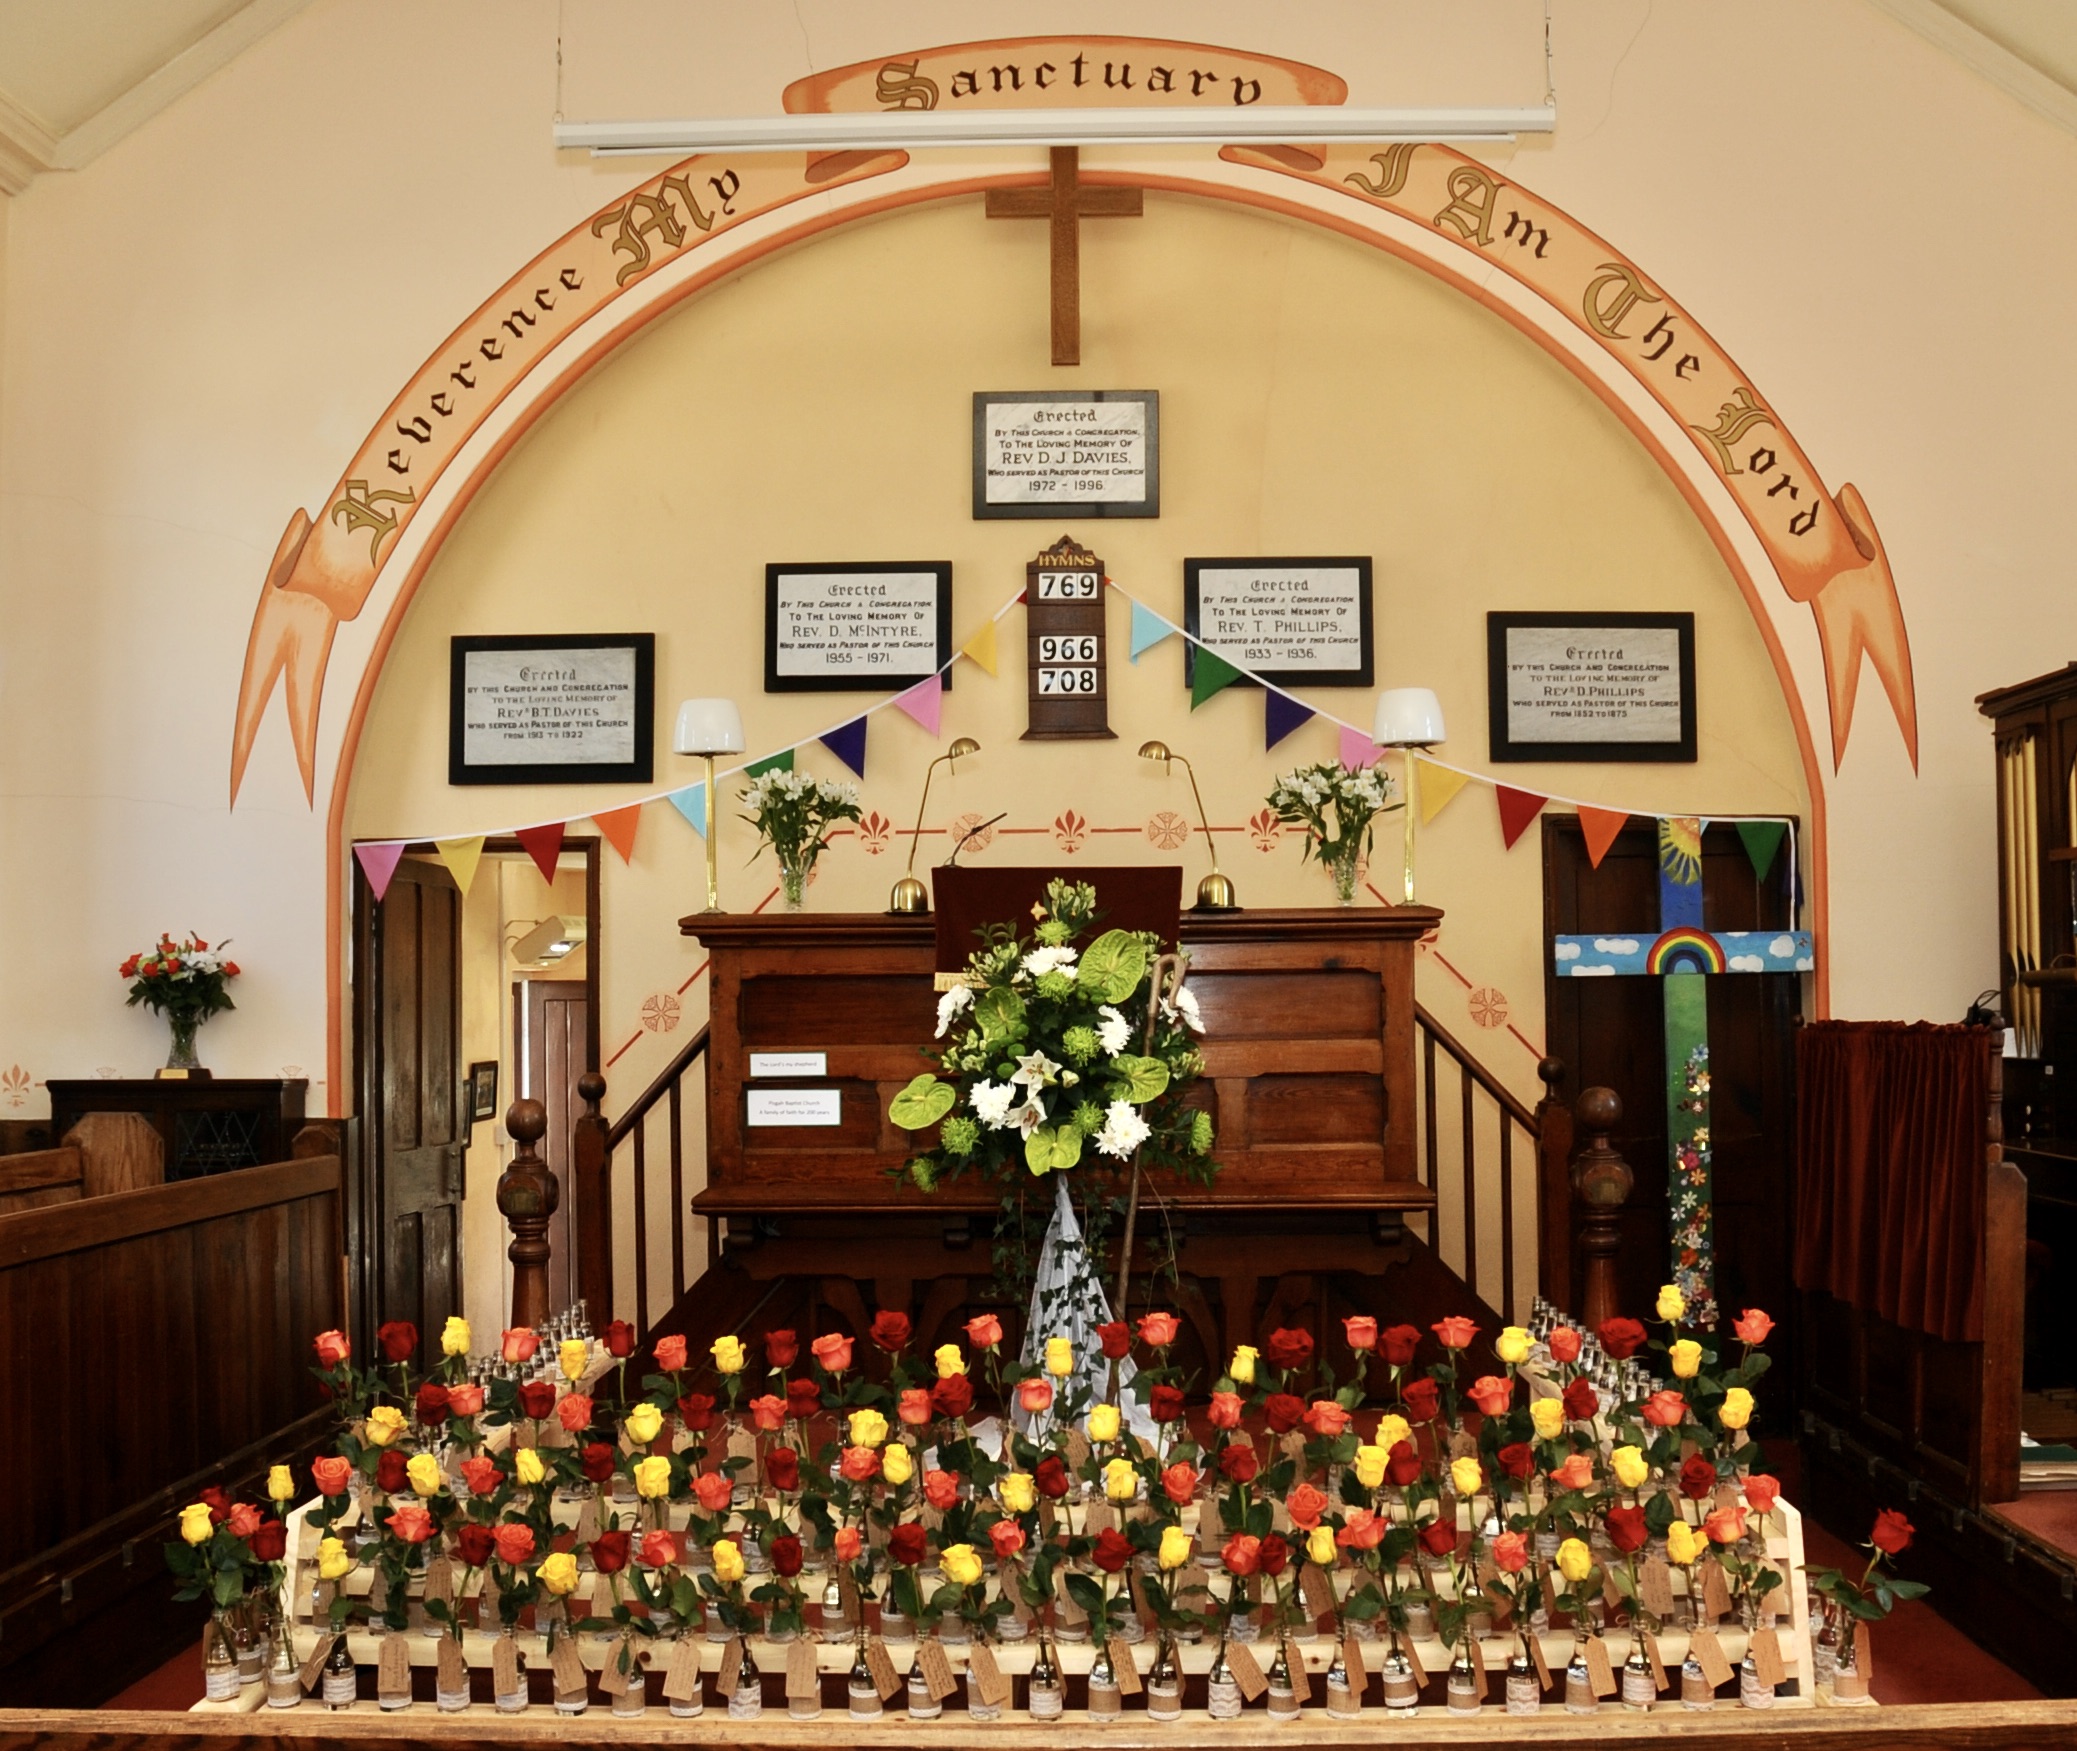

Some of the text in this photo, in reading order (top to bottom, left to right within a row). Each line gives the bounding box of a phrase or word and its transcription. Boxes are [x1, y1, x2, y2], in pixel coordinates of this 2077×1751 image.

[875, 50, 1262, 112] Sanctuary
[1433, 165, 1552, 259] Am
[1582, 262, 1700, 382] The
[1687, 386, 1820, 536] Lord
[331, 168, 740, 568] Reverence My
[1033, 409, 1097, 423] Erected
[999, 440, 1133, 449] TO THE LOVING MEMORY OF
[1029, 481, 1056, 491] 1972
[1038, 555, 1096, 567] HYMNS
[828, 584, 887, 596] Erected
[1041, 575, 1095, 597] 769
[1251, 580, 1309, 591] Erected
[789, 613, 801, 621] TO
[807, 613, 824, 621] THE
[829, 613, 862, 621] LOVING
[914, 612, 924, 620] OF
[1213, 608, 1224, 616] TO
[1230, 608, 1246, 616] THE
[1251, 608, 1285, 616] LOVING
[1042, 638, 1094, 660] 966
[1245, 649, 1272, 659] 1933
[1566, 646, 1624, 661] Erected
[826, 653, 853, 664] 1955
[519, 667, 576, 681] Erected
[1041, 670, 1094, 692] 708
